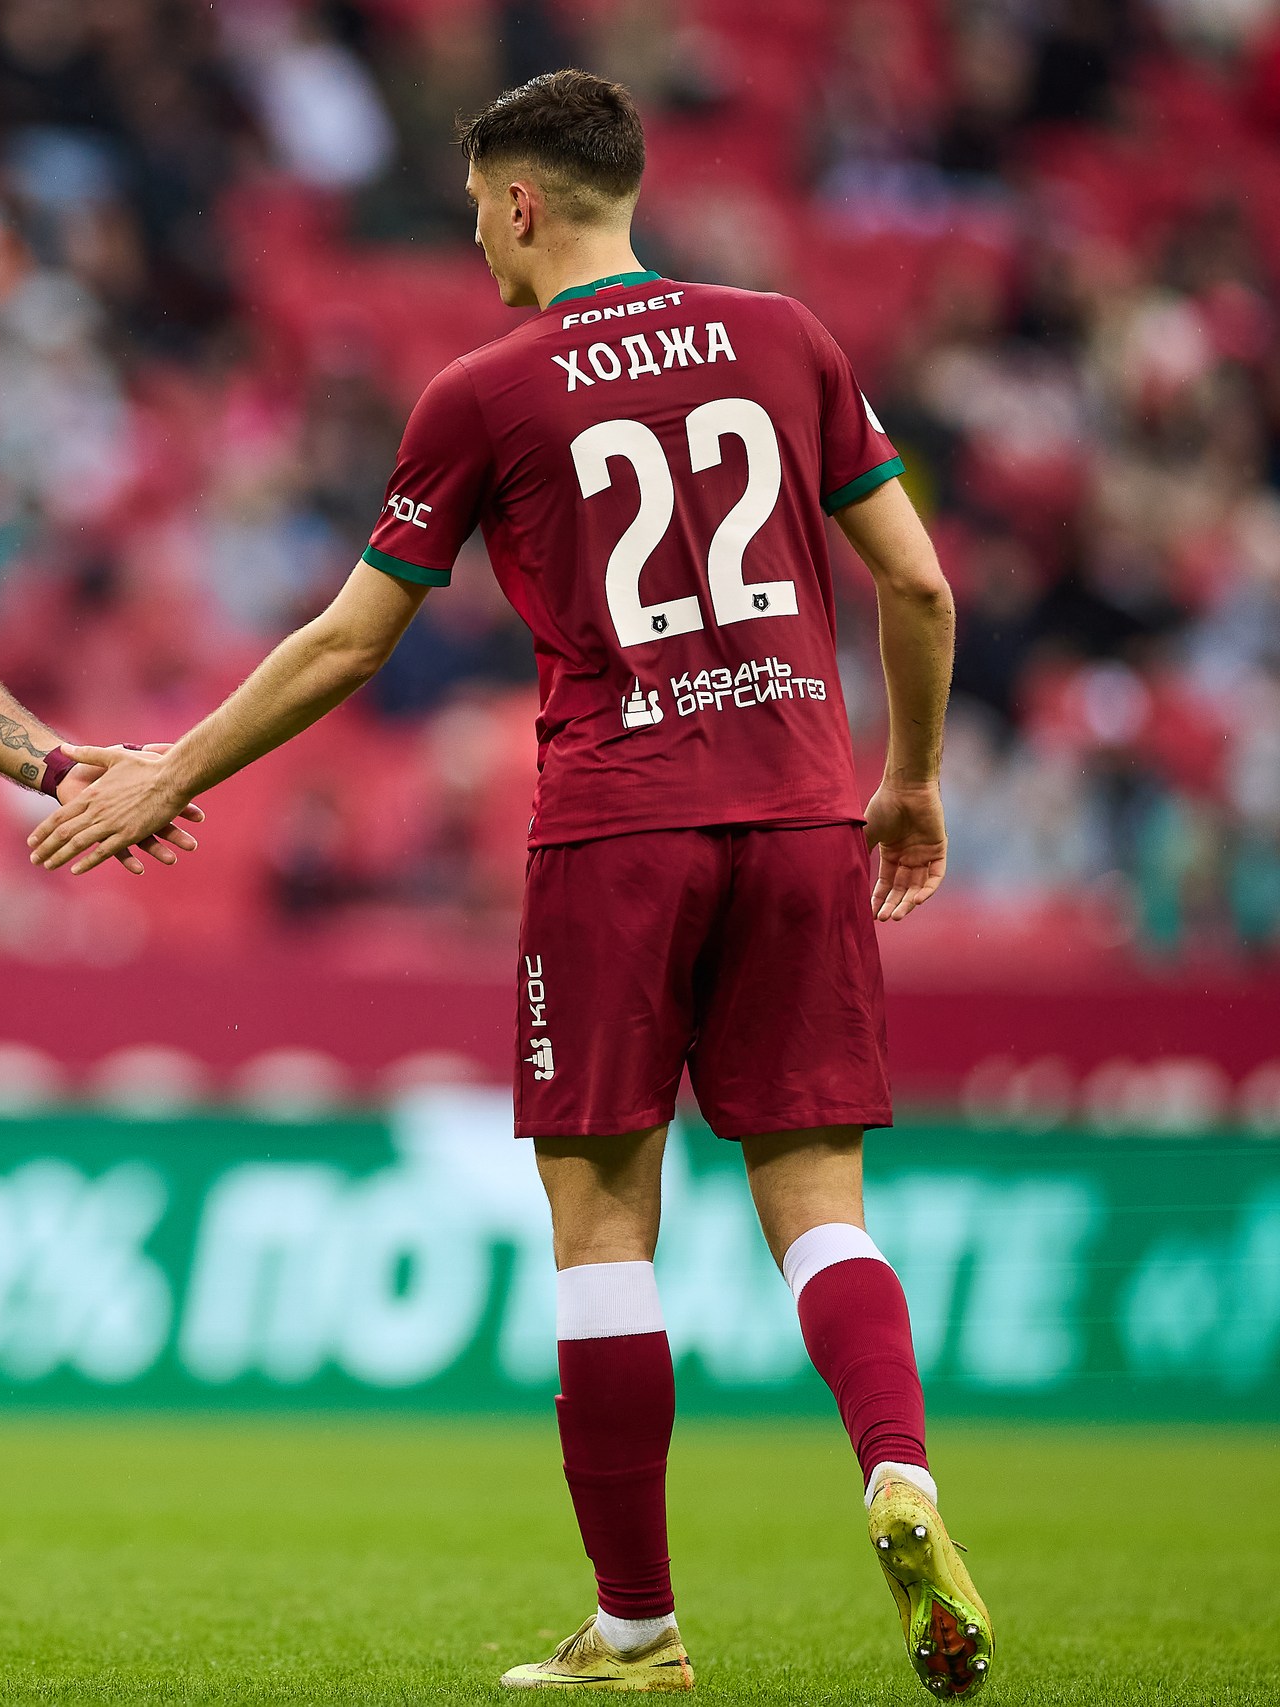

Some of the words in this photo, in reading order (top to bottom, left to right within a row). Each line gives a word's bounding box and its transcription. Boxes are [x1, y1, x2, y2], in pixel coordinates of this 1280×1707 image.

[562, 291, 684, 329] FONBET
[551, 322, 737, 392] ХОДЖА
[569, 397, 799, 648] 22
[670, 656, 792, 697] КАЗАНЬ
[676, 677, 827, 717] ОРГСИНТЕЗ
[525, 954, 547, 1027] КОС
